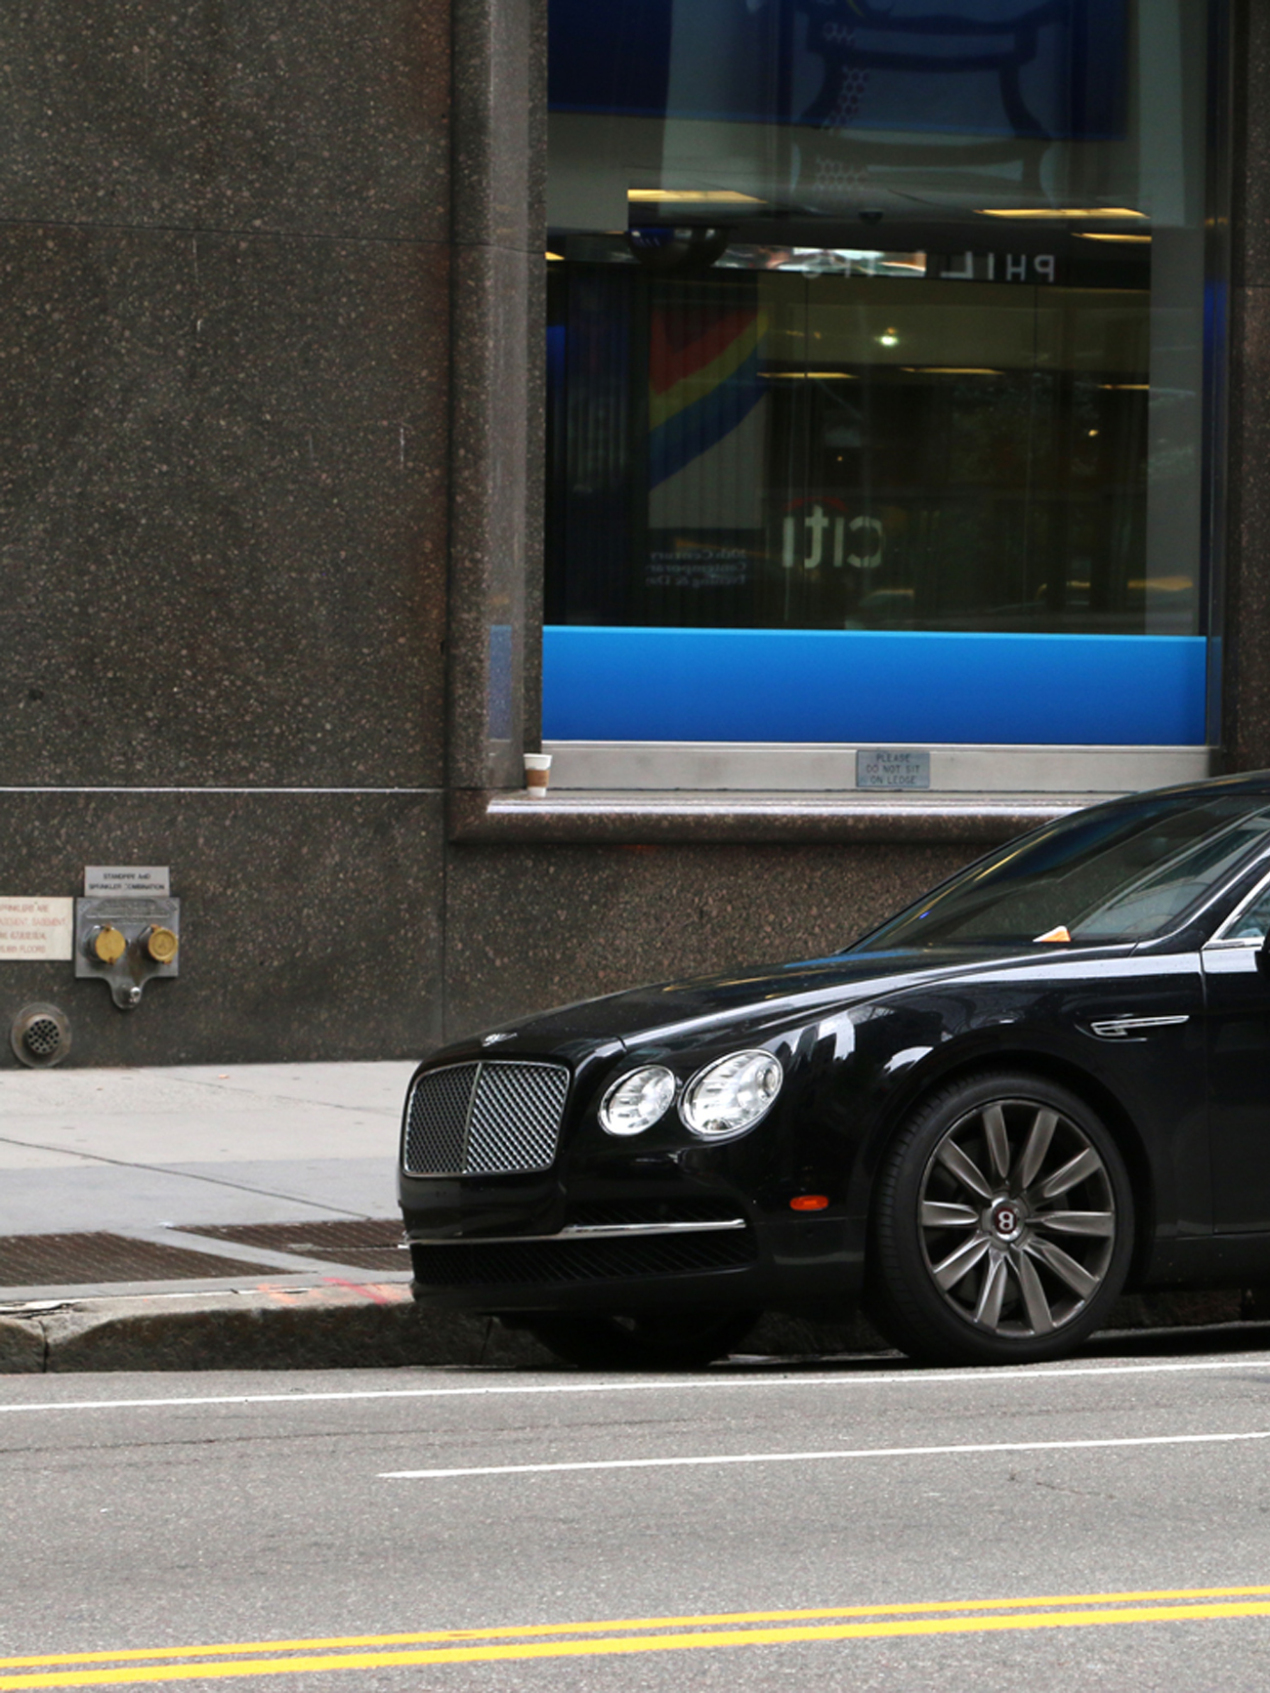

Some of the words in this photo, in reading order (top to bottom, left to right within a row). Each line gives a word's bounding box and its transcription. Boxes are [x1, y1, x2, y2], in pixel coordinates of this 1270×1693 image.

[876, 753, 911, 763] PLEASE
[866, 764, 879, 774] DO
[883, 764, 901, 774] NOT
[906, 764, 920, 774] SIT
[870, 775, 883, 785] ON
[887, 775, 917, 785] LEDGE
